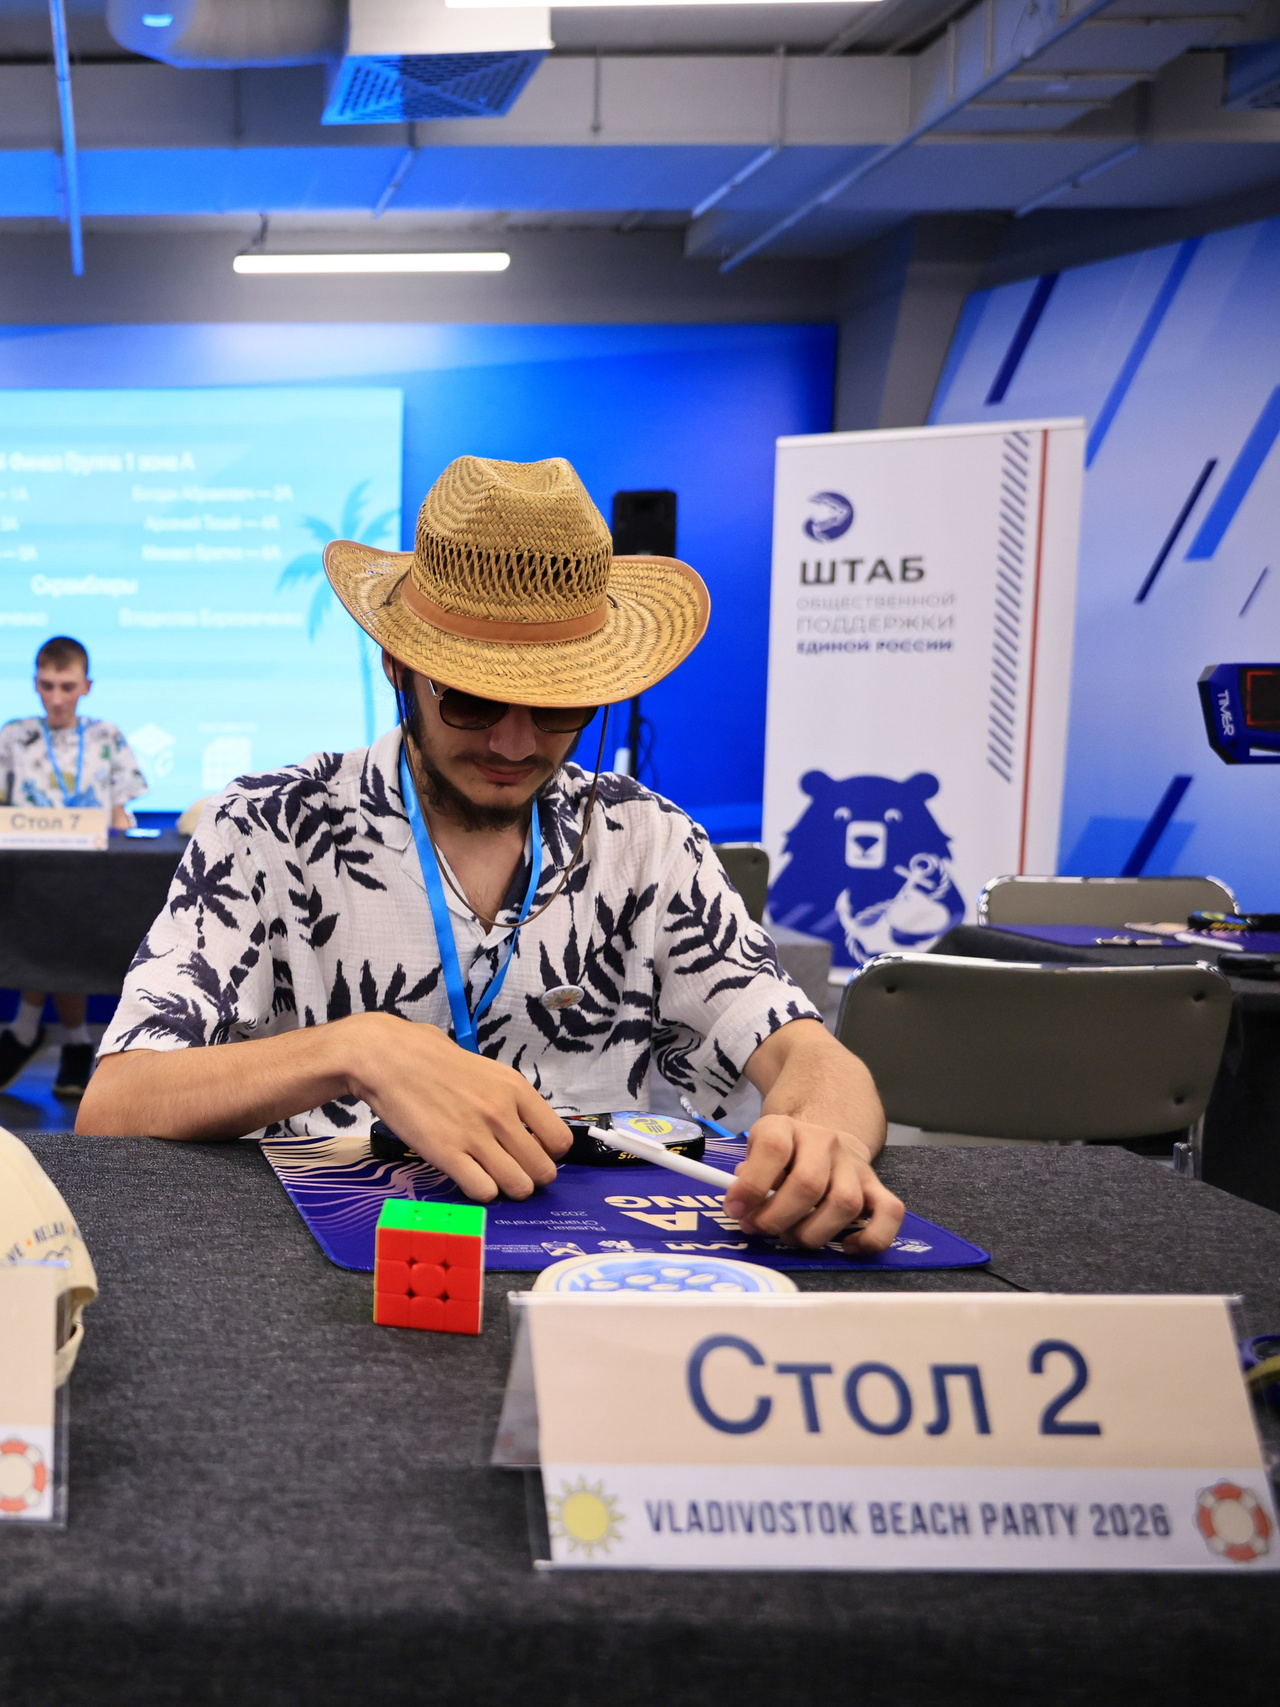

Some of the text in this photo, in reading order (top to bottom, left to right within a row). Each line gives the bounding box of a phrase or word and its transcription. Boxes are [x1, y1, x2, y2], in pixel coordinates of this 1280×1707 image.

[800, 555, 925, 585] ШТАБ
[796, 592, 956, 611] ОБЩЕСТВЕННОЙ
[796, 614, 954, 634] ПОДДЕРЖКИ
[796, 637, 953, 655] ЕДИНОЙ РОССИИ
[1217, 689, 1235, 736] TIMER
[10, 812, 81, 830] Стол 7
[619, 1211, 743, 1231] EA
[685, 1332, 1102, 1436] Стол 2
[646, 1500, 1172, 1537] VLADIVOSTOK BEACH PARTY 2026
